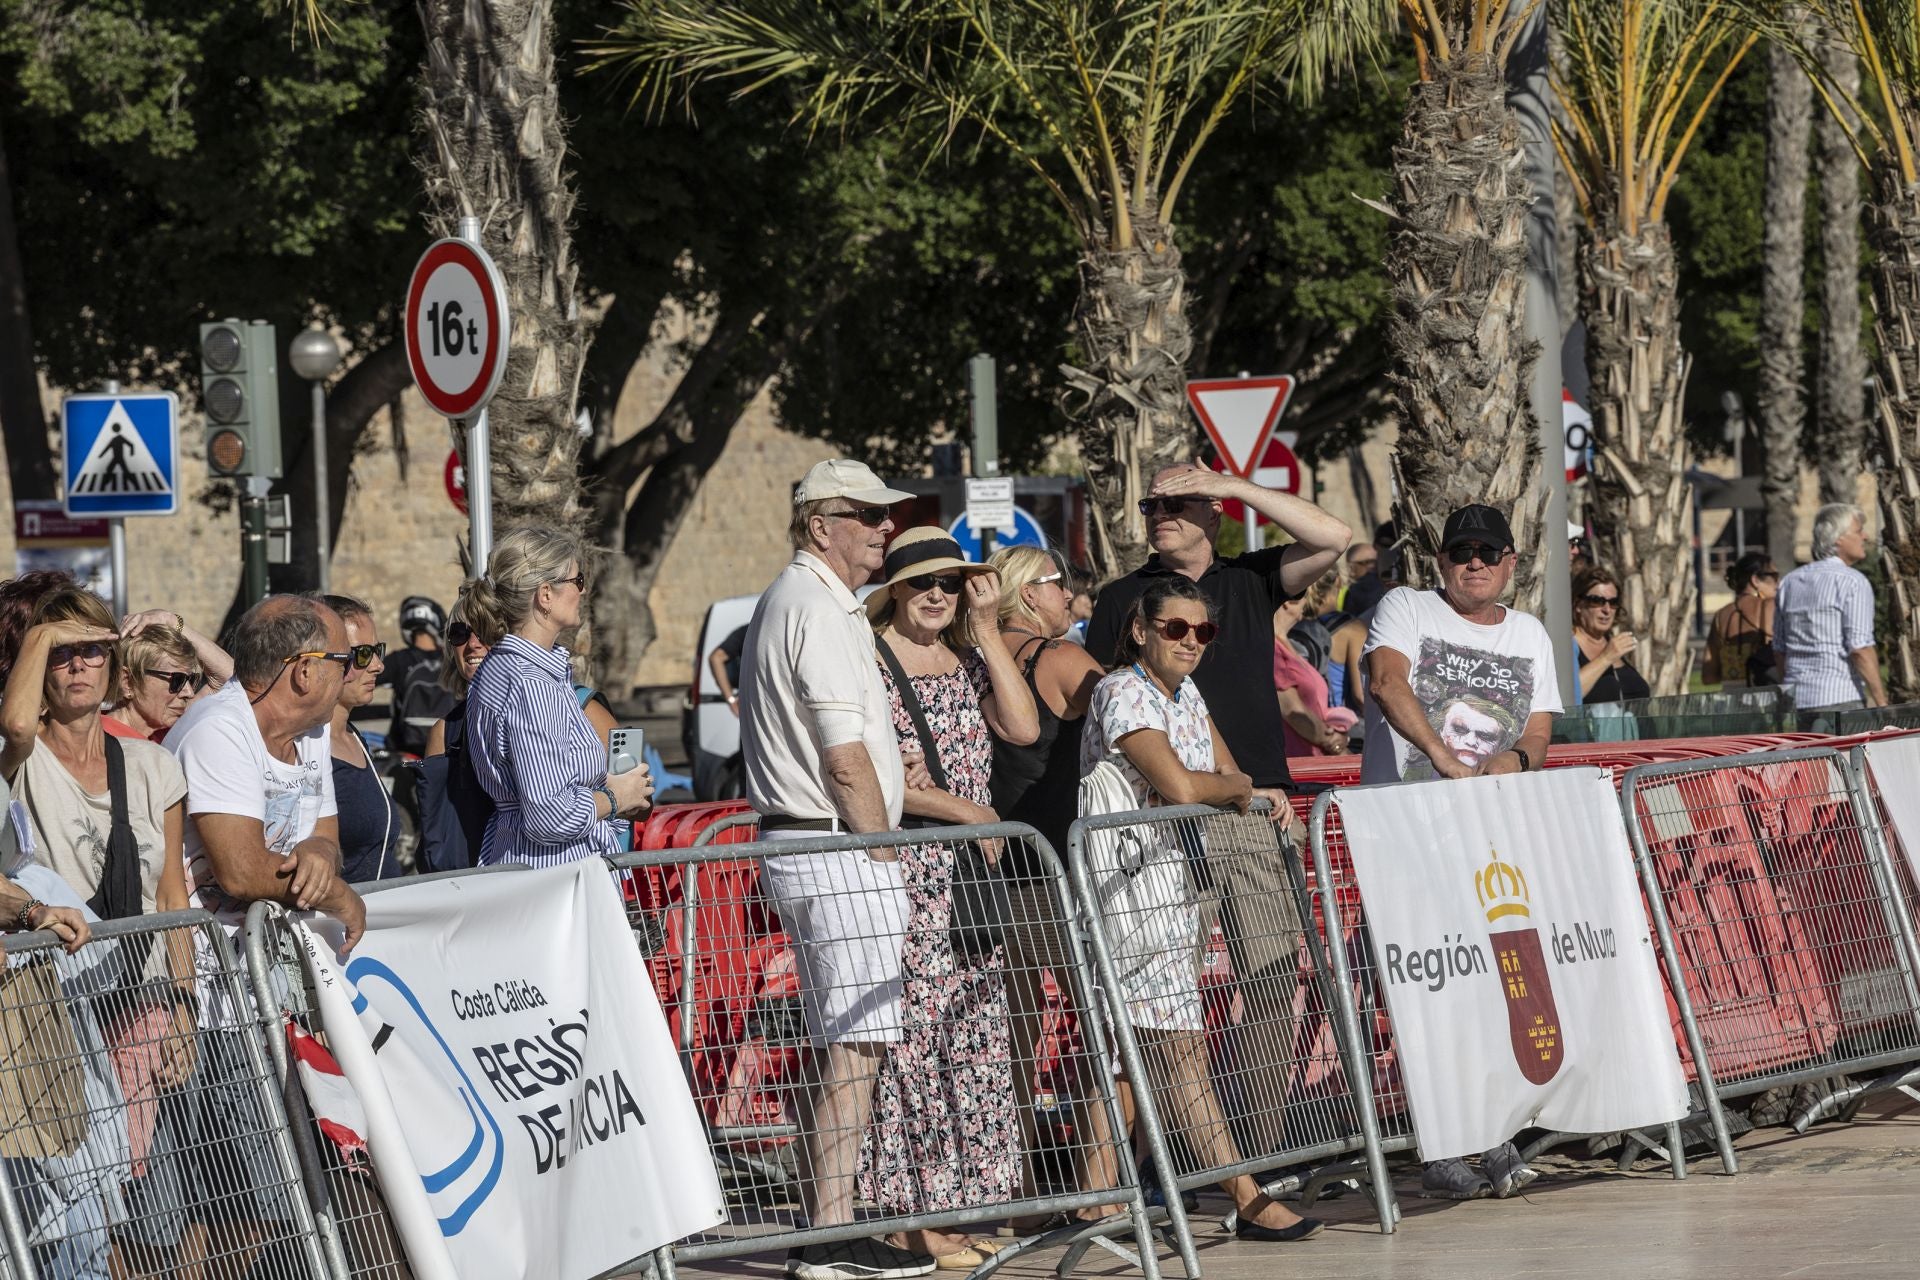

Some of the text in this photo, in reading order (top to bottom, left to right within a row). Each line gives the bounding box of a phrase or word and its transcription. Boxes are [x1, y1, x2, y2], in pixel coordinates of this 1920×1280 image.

[1435, 664, 1520, 694] SERIOUS?
[1446, 653, 1512, 678] WHY SO
[1385, 933, 1488, 992] Región
[1551, 922, 1577, 965] de
[451, 979, 548, 1020] Costa Cálida
[517, 1103, 566, 1175] DE
